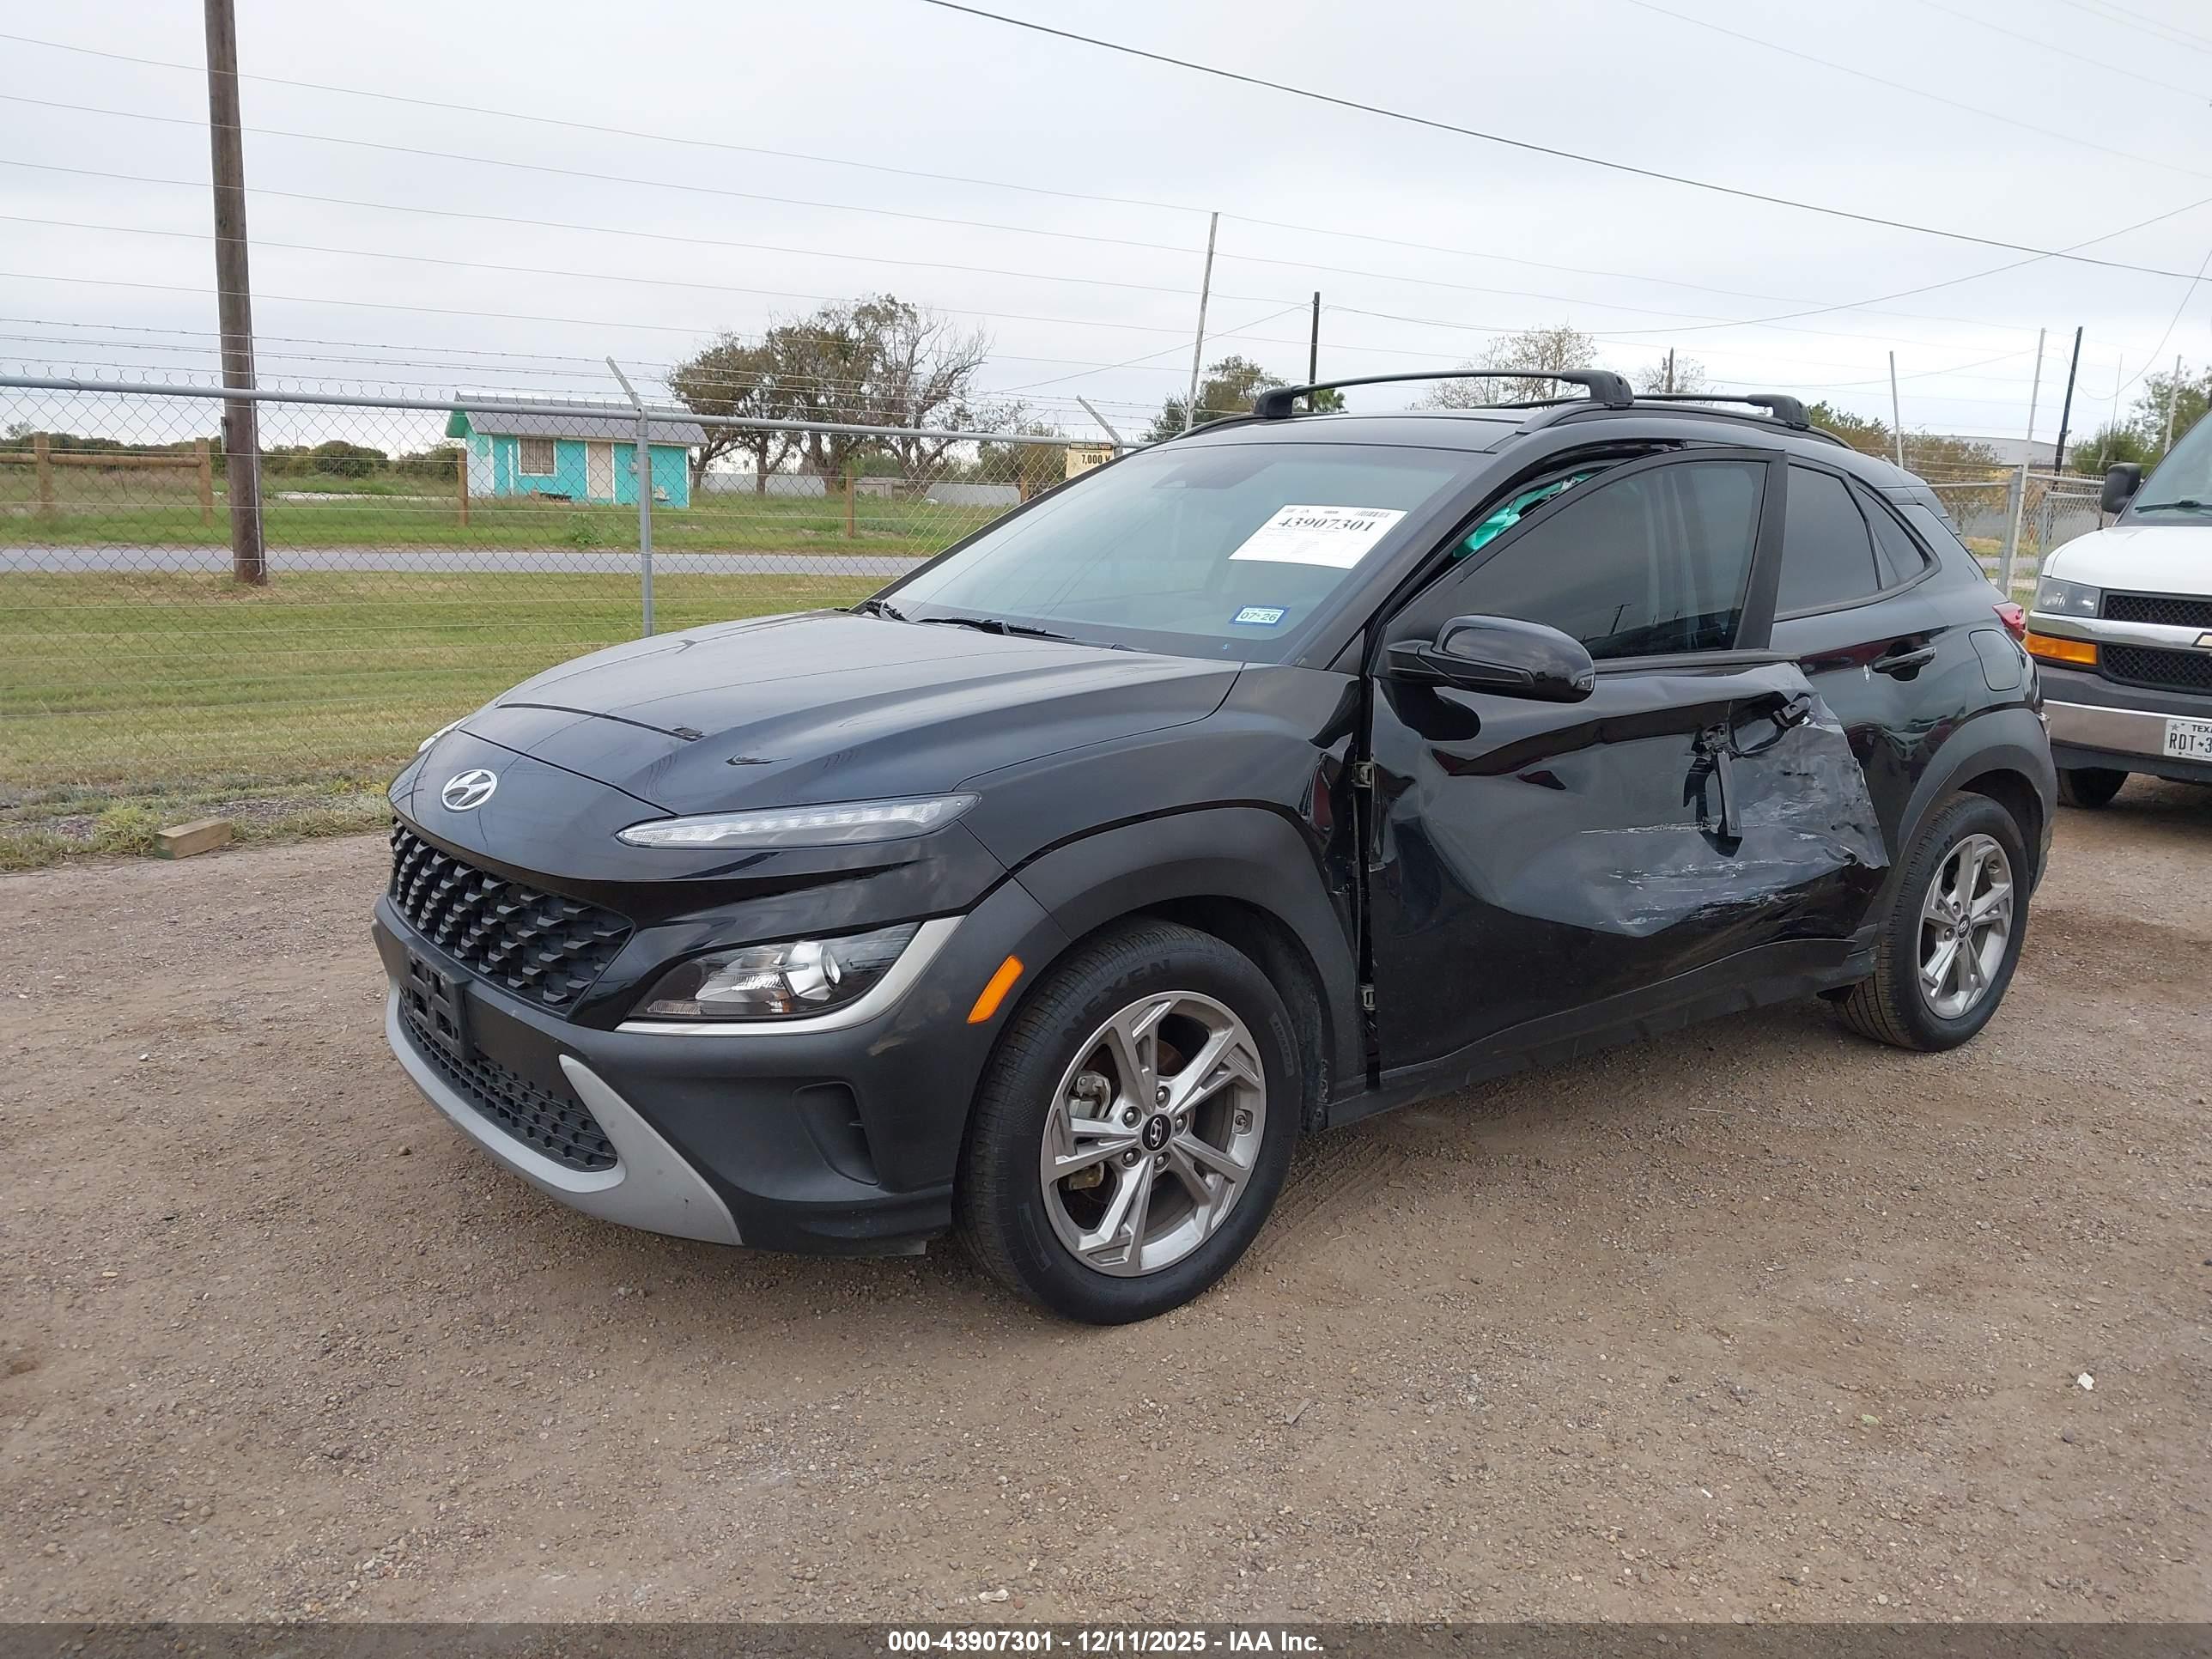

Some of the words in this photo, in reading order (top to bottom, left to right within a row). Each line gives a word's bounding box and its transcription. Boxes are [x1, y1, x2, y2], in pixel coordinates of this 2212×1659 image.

[1082, 454, 1103, 465] 7,000
[1278, 517, 1376, 532] 43907301
[1240, 611, 1256, 620] 07
[1260, 613, 1279, 622] 26
[2191, 724, 2212, 733] TEX
[1063, 957, 1172, 1038] NEXEN
